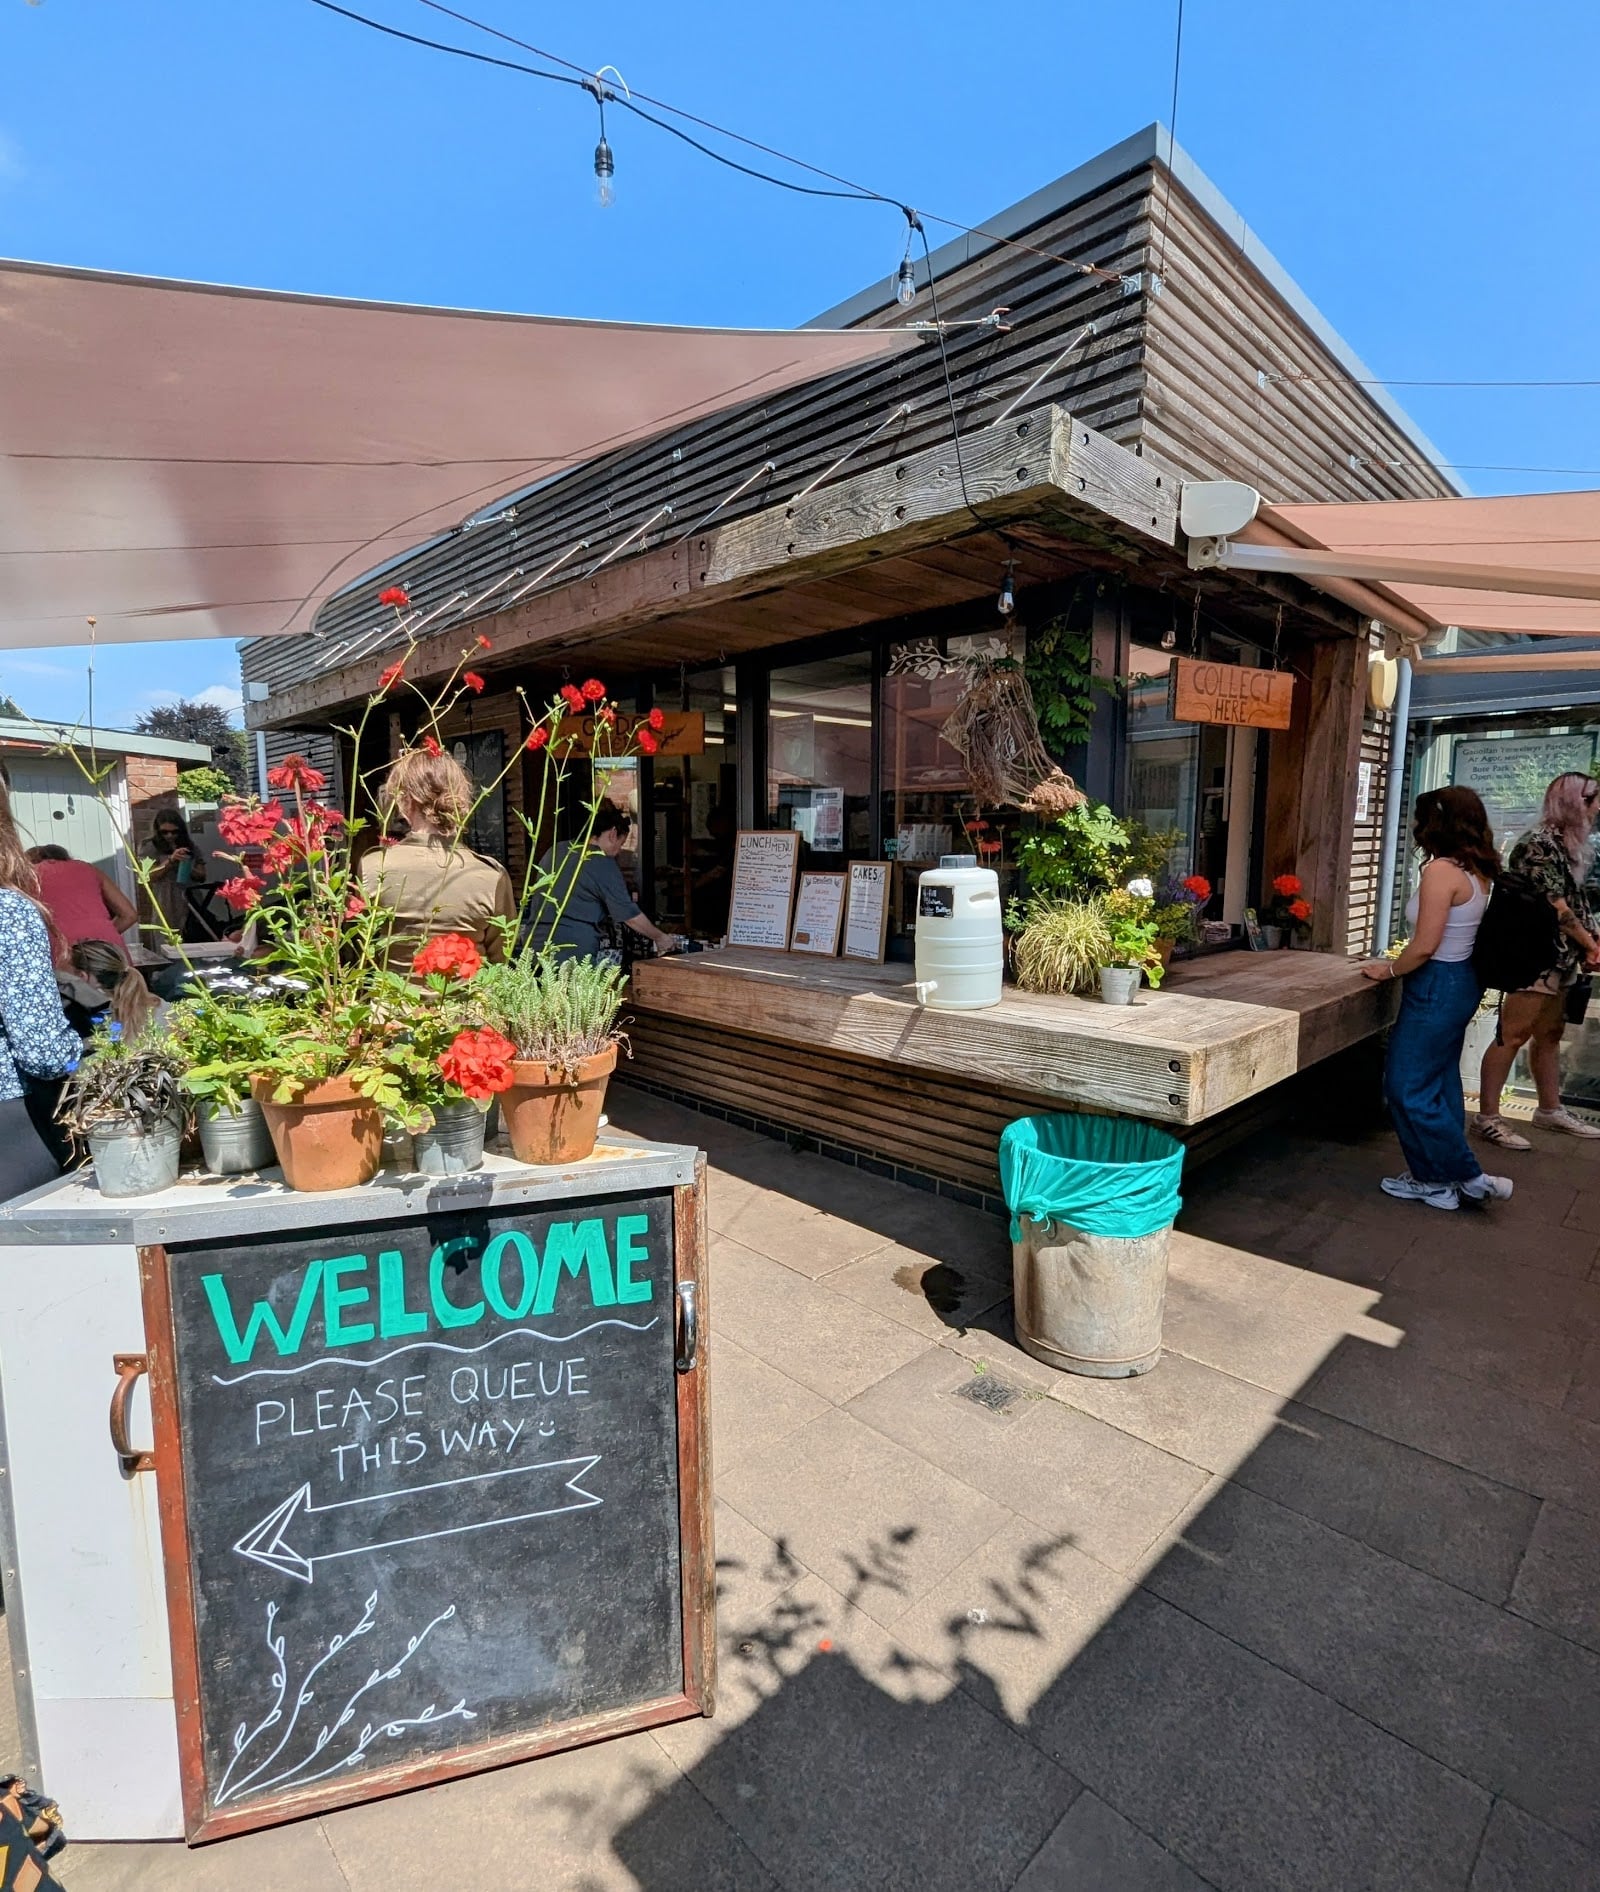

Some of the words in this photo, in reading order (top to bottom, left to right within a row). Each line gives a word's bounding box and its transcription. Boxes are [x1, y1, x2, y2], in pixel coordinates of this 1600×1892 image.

[1193, 665, 1276, 703] COLLECT
[1214, 698, 1248, 723] HERE
[1492, 764, 1509, 772] Park
[740, 836, 771, 849] LUNCH
[771, 843, 793, 852] MENU
[852, 867, 878, 880] CAKES
[201, 1214, 653, 1363] WELCOME
[255, 1374, 426, 1445] PLEASE
[450, 1357, 590, 1403] QUEUE
[331, 1432, 427, 1482] THIS
[440, 1417, 525, 1457] WAY
